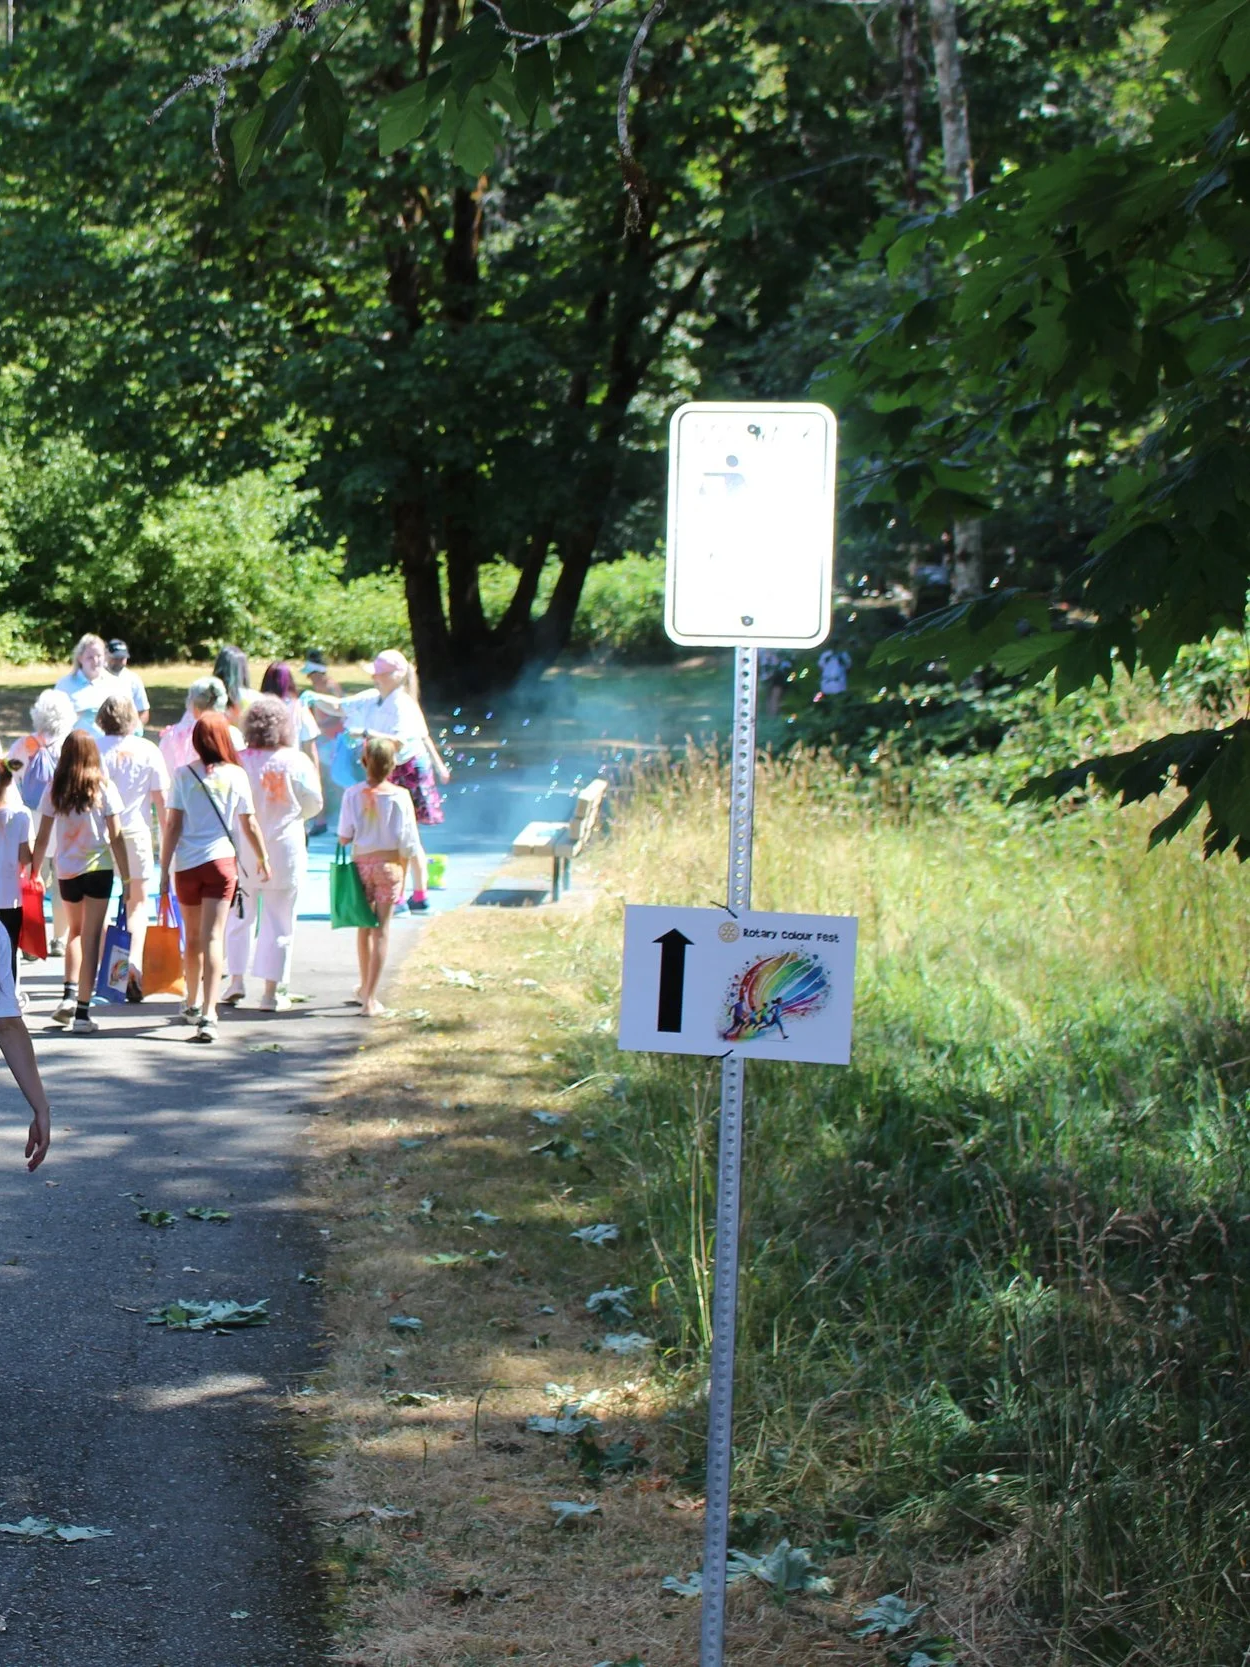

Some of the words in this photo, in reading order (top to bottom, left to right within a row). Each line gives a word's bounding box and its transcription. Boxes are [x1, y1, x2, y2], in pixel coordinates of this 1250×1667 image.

[743, 928, 777, 939] Rotary
[781, 931, 813, 941] Colour
[816, 933, 840, 943] Fest
